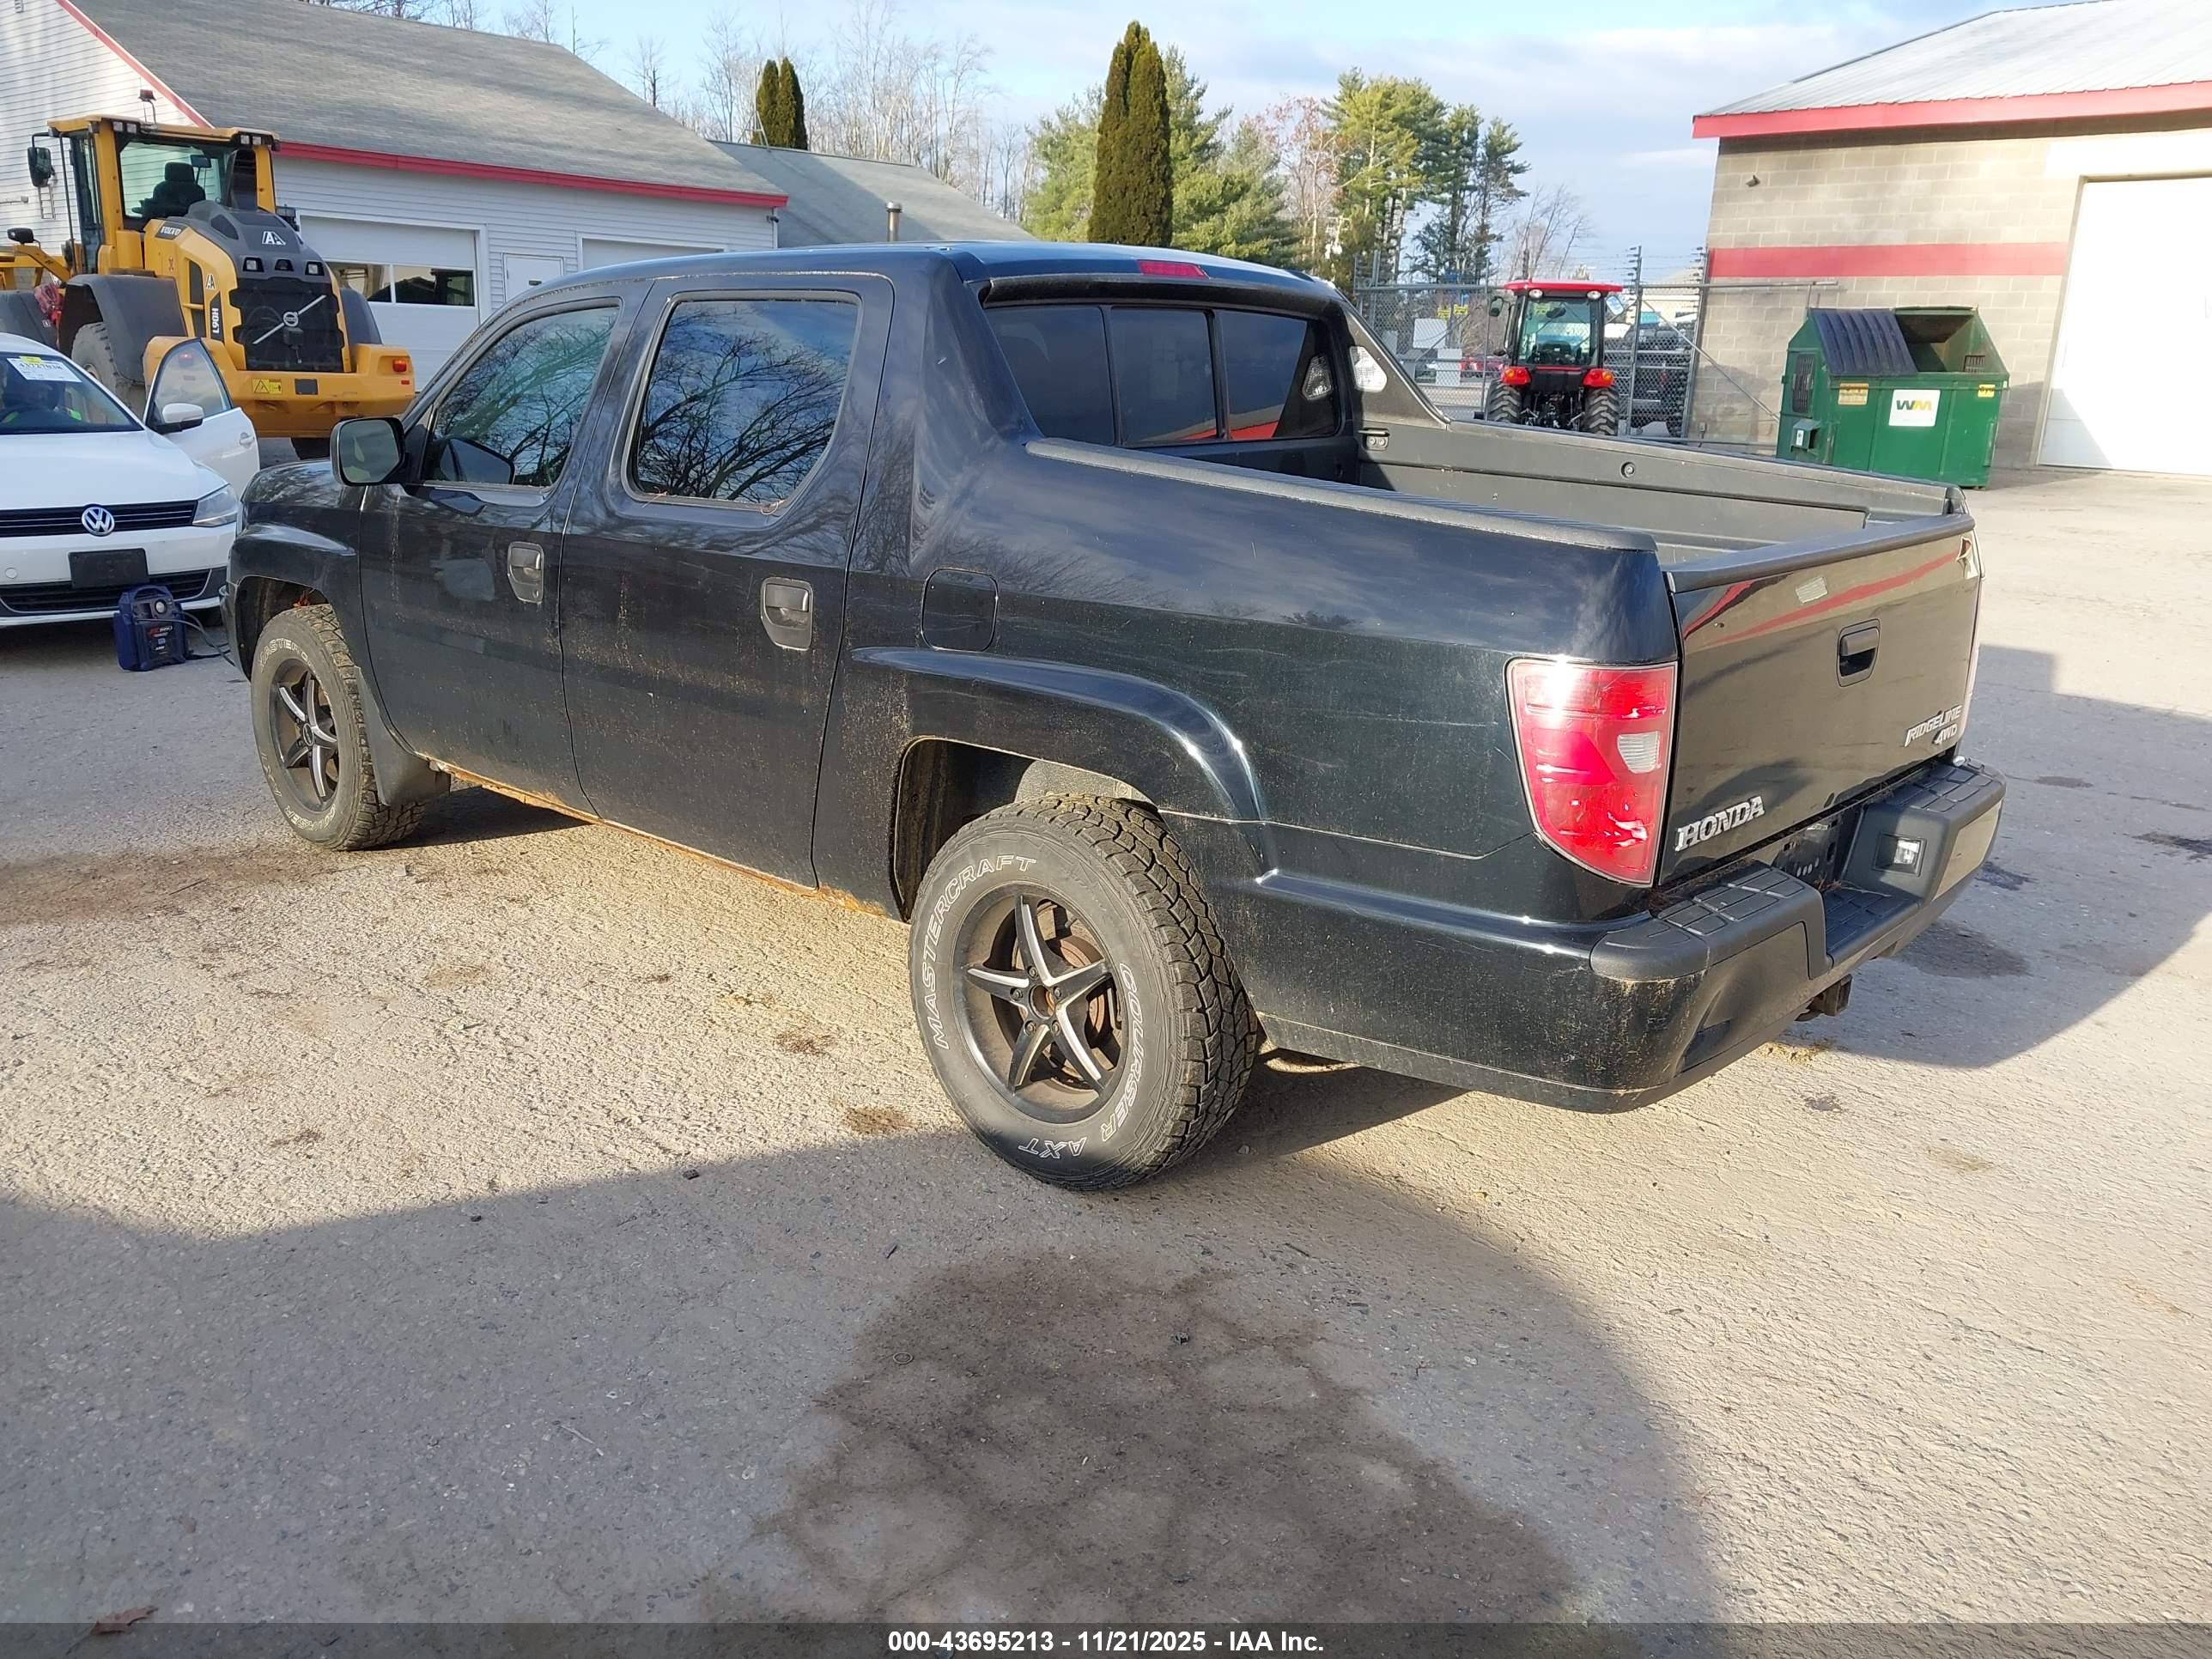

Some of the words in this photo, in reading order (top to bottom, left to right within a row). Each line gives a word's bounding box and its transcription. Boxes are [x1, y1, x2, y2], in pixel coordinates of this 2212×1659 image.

[1896, 399, 1932, 411] WM
[1904, 704, 1963, 747] RIDGELINE
[1933, 723, 1958, 744] 4WD
[1674, 795, 1765, 852] HONDA
[923, 854, 1037, 1050] MASTERCRAFT
[1101, 962, 1146, 1143] COURSER
[1018, 1137, 1087, 1159] AXT
